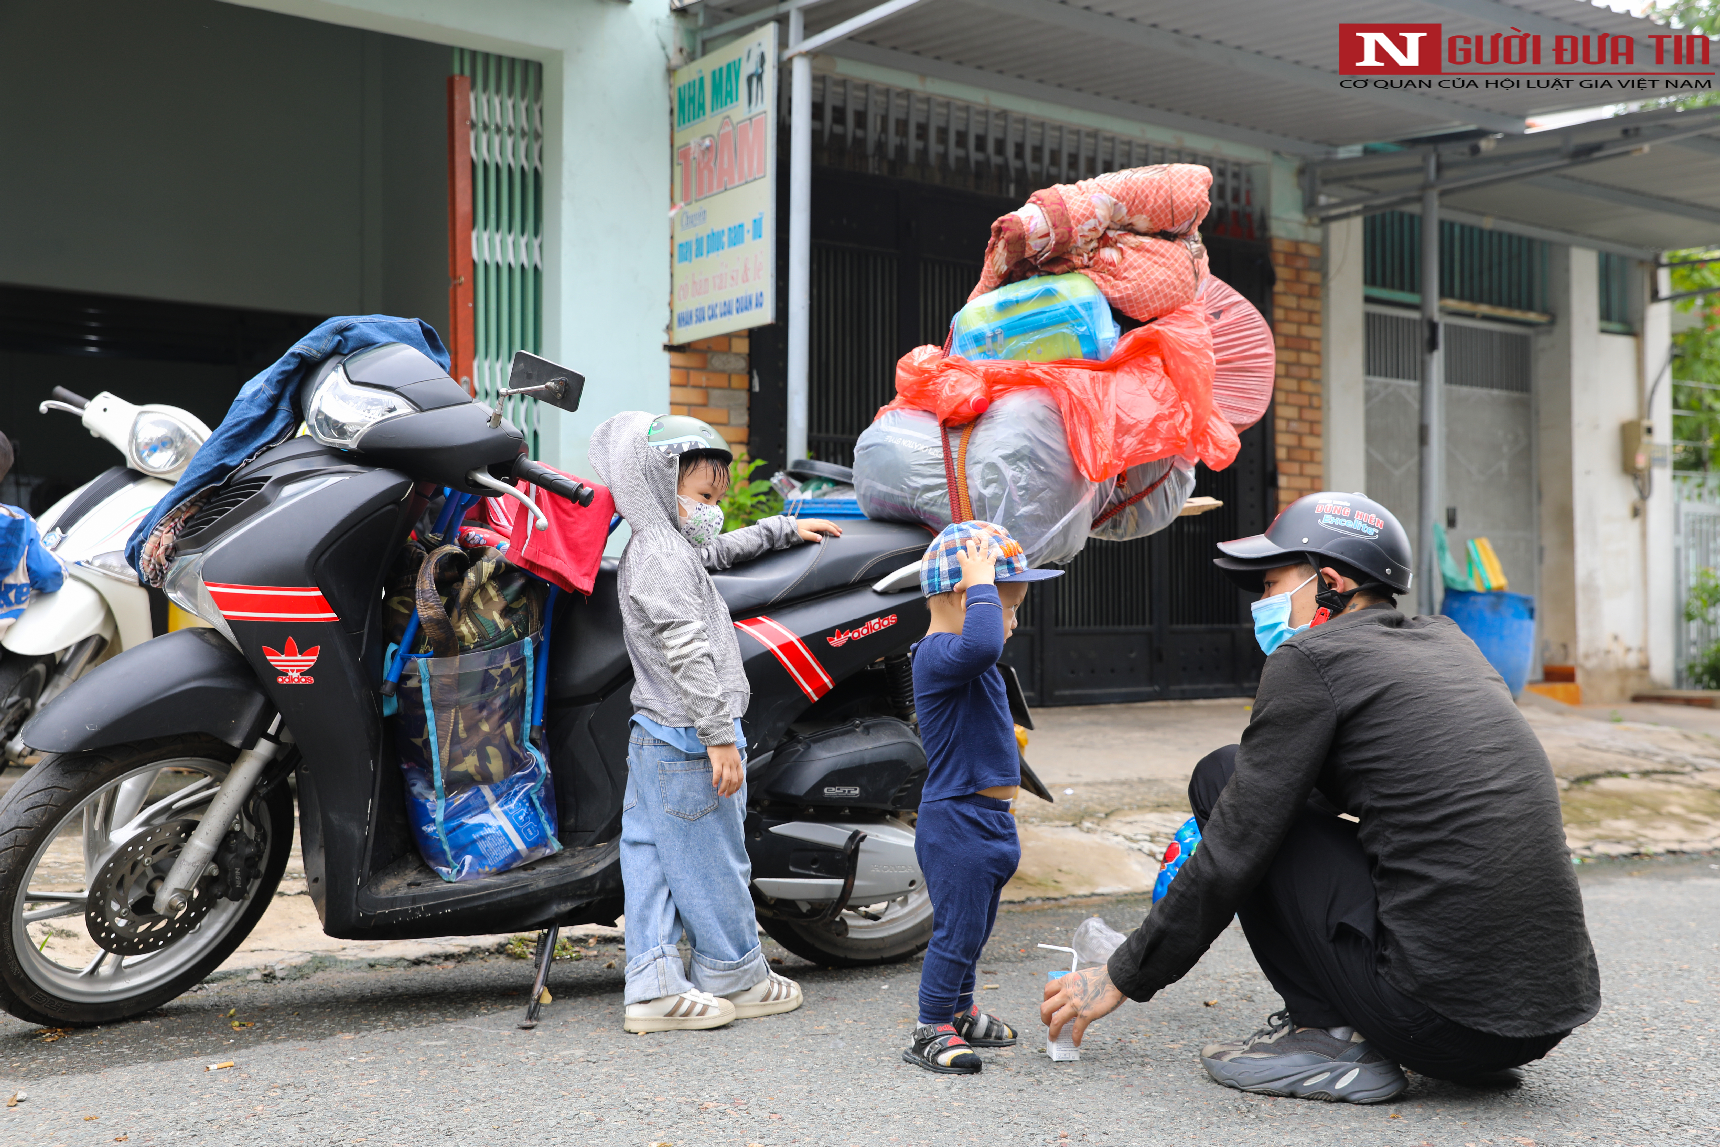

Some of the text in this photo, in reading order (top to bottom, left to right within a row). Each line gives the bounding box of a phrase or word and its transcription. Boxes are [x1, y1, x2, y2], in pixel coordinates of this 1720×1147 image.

[677, 57, 742, 129] NHÀ MAY
[677, 111, 767, 206] TRÂM
[727, 222, 745, 248] nam
[851, 614, 898, 641] adidas
[276, 675, 315, 685] adidas
[871, 865, 915, 873] HONDA
